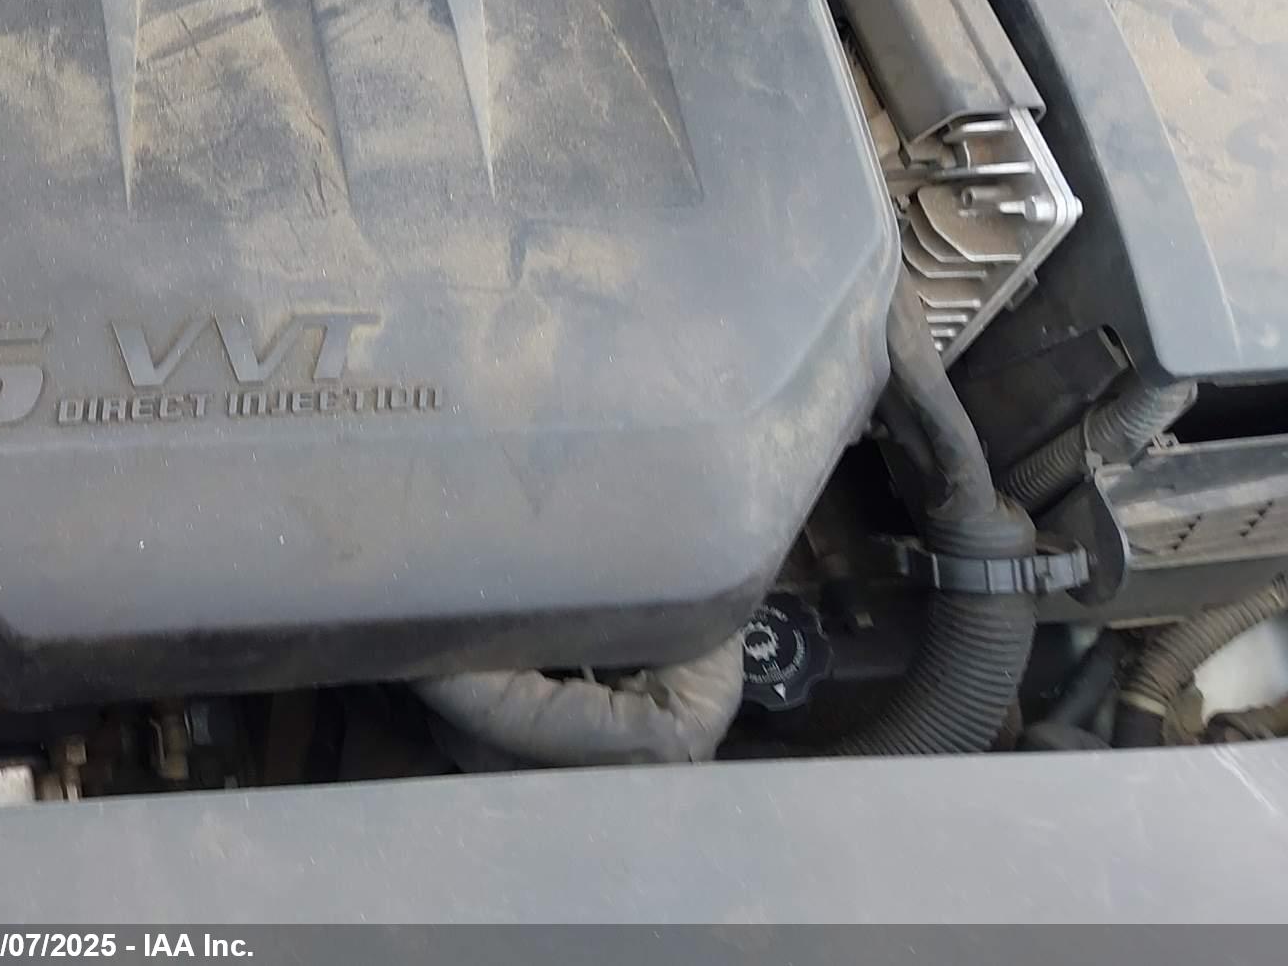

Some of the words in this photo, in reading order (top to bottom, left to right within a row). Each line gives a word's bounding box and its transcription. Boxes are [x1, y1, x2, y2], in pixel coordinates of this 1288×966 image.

[111, 311, 380, 388] VVT
[56, 391, 212, 425] DIRECT
[226, 384, 444, 417] INJECTION
